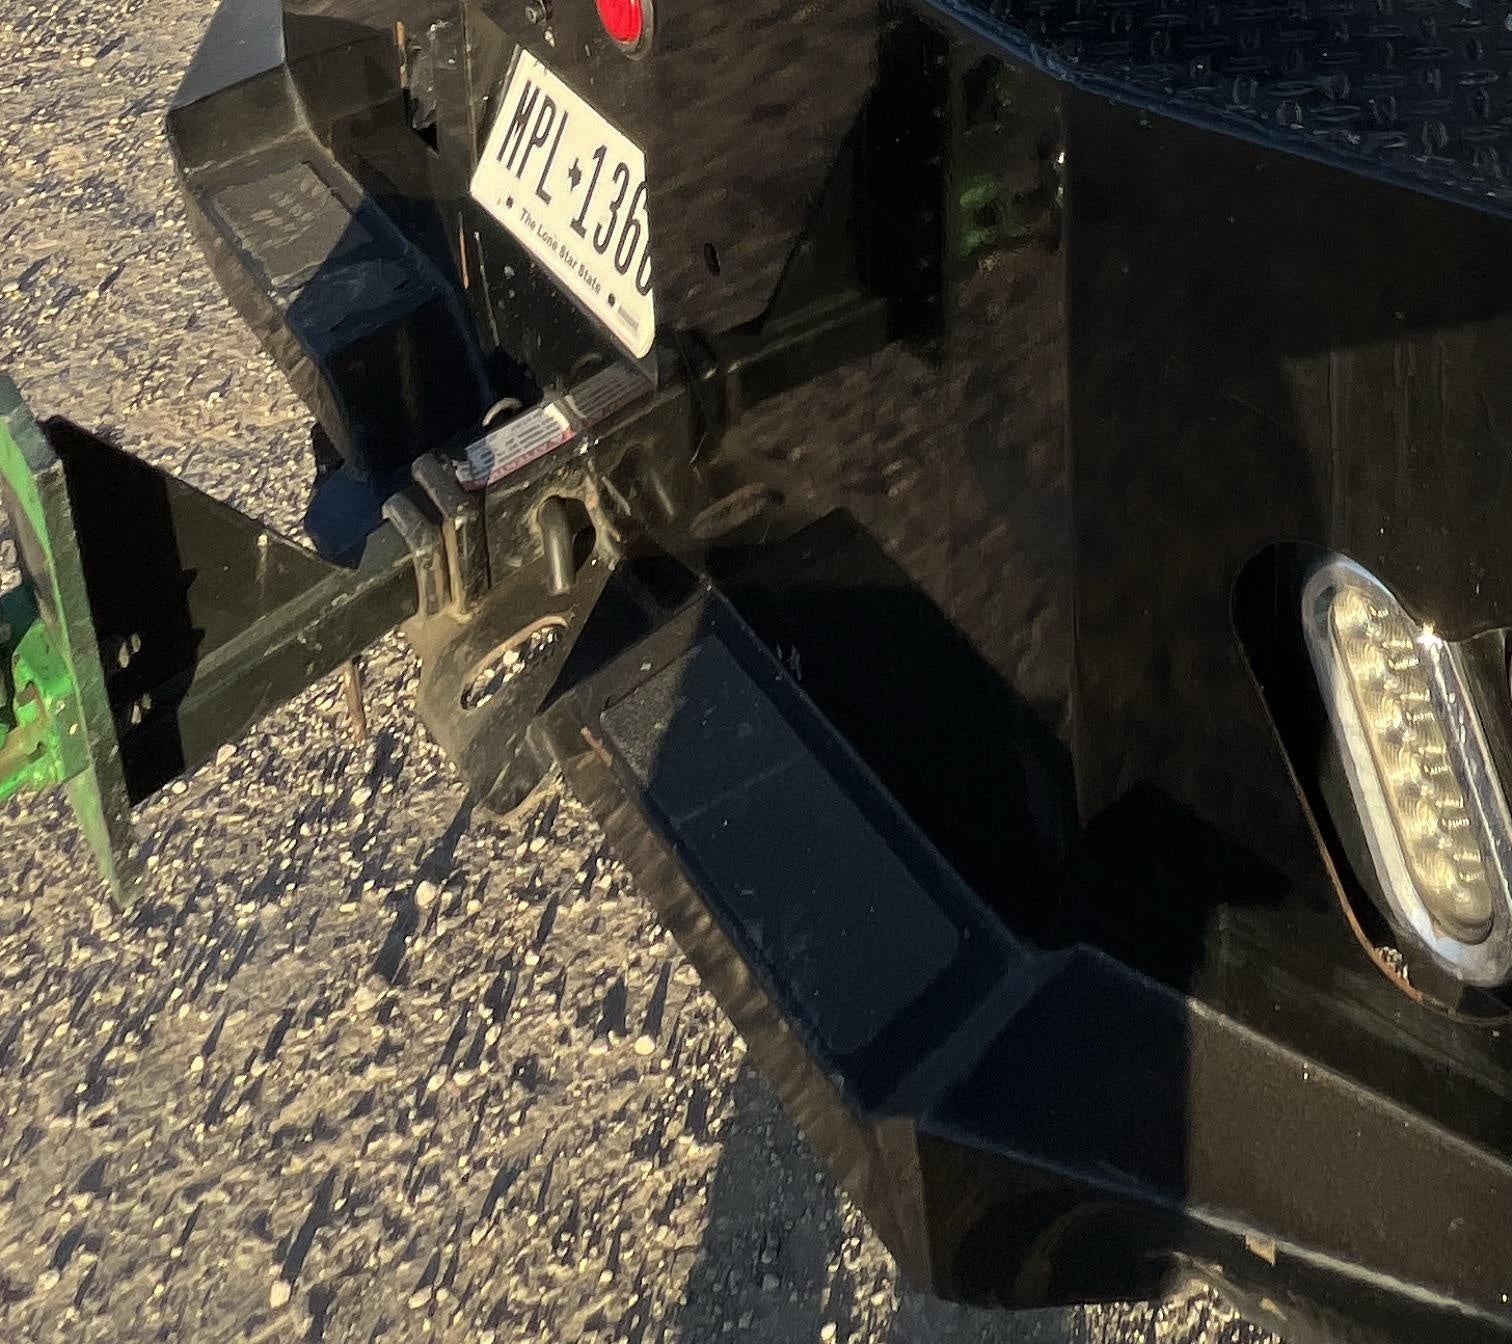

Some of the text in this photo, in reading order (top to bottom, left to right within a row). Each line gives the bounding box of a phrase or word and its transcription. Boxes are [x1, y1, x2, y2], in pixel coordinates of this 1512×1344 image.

[520, 207, 602, 294] The Lone Star State
